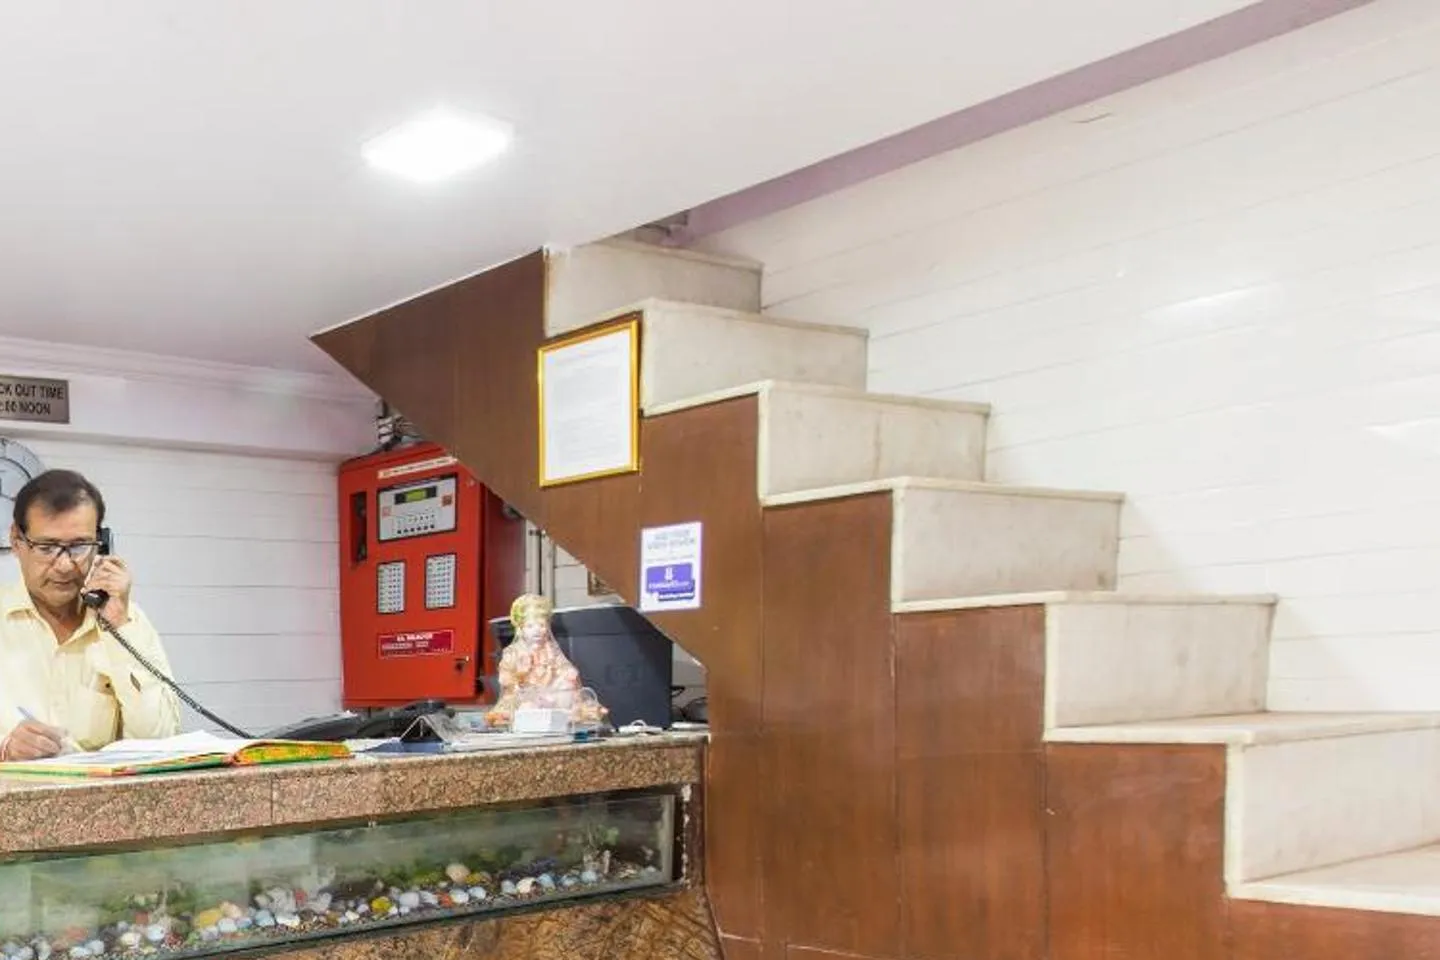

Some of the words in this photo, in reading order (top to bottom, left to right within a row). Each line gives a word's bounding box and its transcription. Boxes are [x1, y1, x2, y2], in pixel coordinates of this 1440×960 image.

[15, 383, 36, 397] OUT
[40, 385, 64, 400] TIME
[19, 401, 51, 415] NOON
